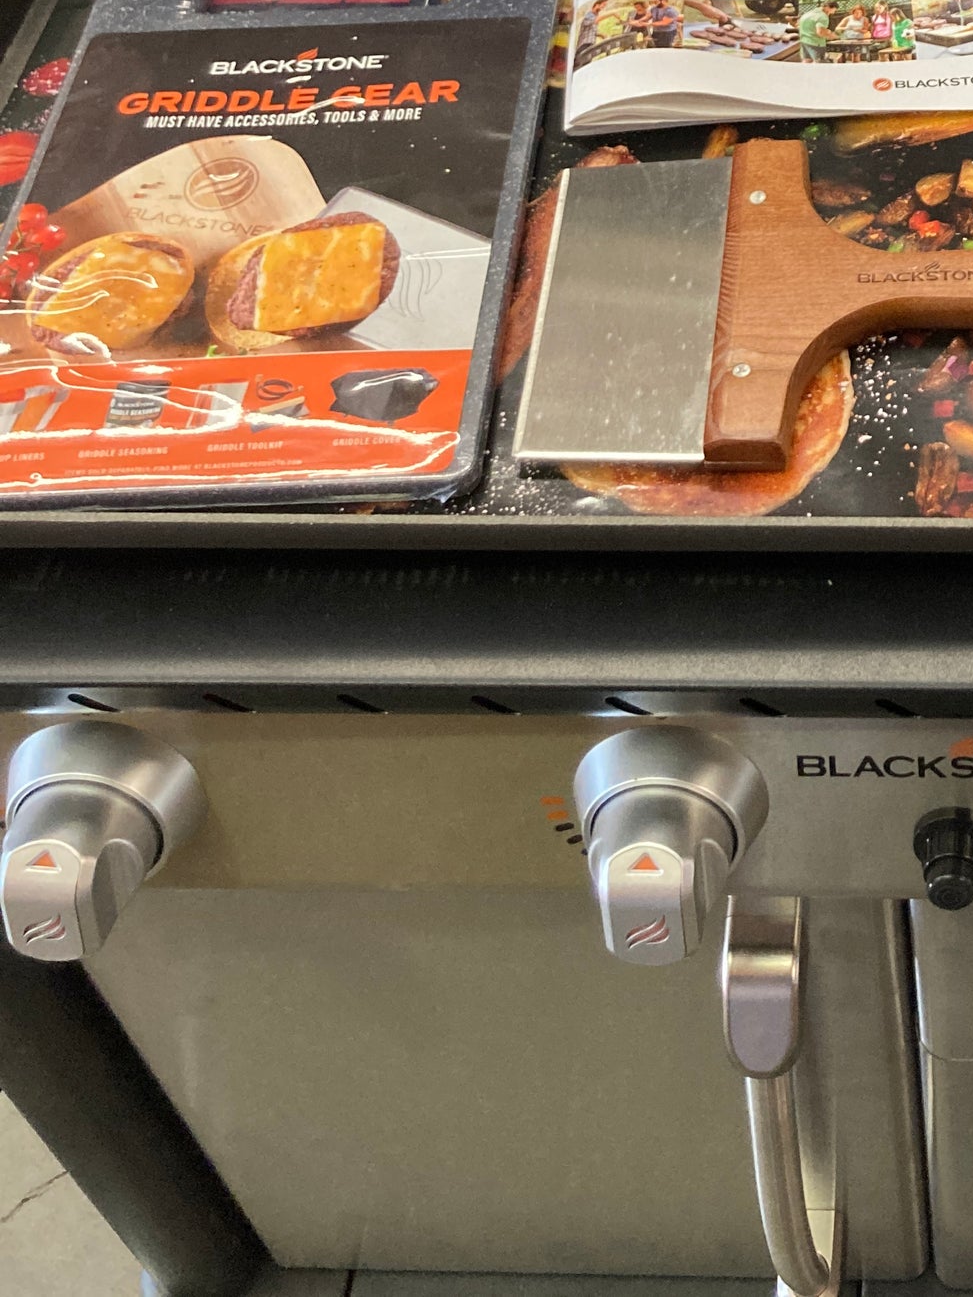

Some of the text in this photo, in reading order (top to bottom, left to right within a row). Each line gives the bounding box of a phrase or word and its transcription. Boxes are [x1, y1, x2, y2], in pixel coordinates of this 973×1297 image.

[209, 54, 384, 76] BLACKSTONE
[119, 80, 460, 115] GRIDDLE GEAR
[146, 107, 422, 128] MUST HAVE ACCESSORIES, TOOLS & MORE
[126, 205, 268, 237] BLACKSTONE
[207, 440, 284, 452] GRIDDLE TOOLKIT
[332, 437, 370, 447] GRIDDLE
[13, 451, 45, 462] LINERS
[78, 446, 168, 459] GRIDDLE SEASONING
